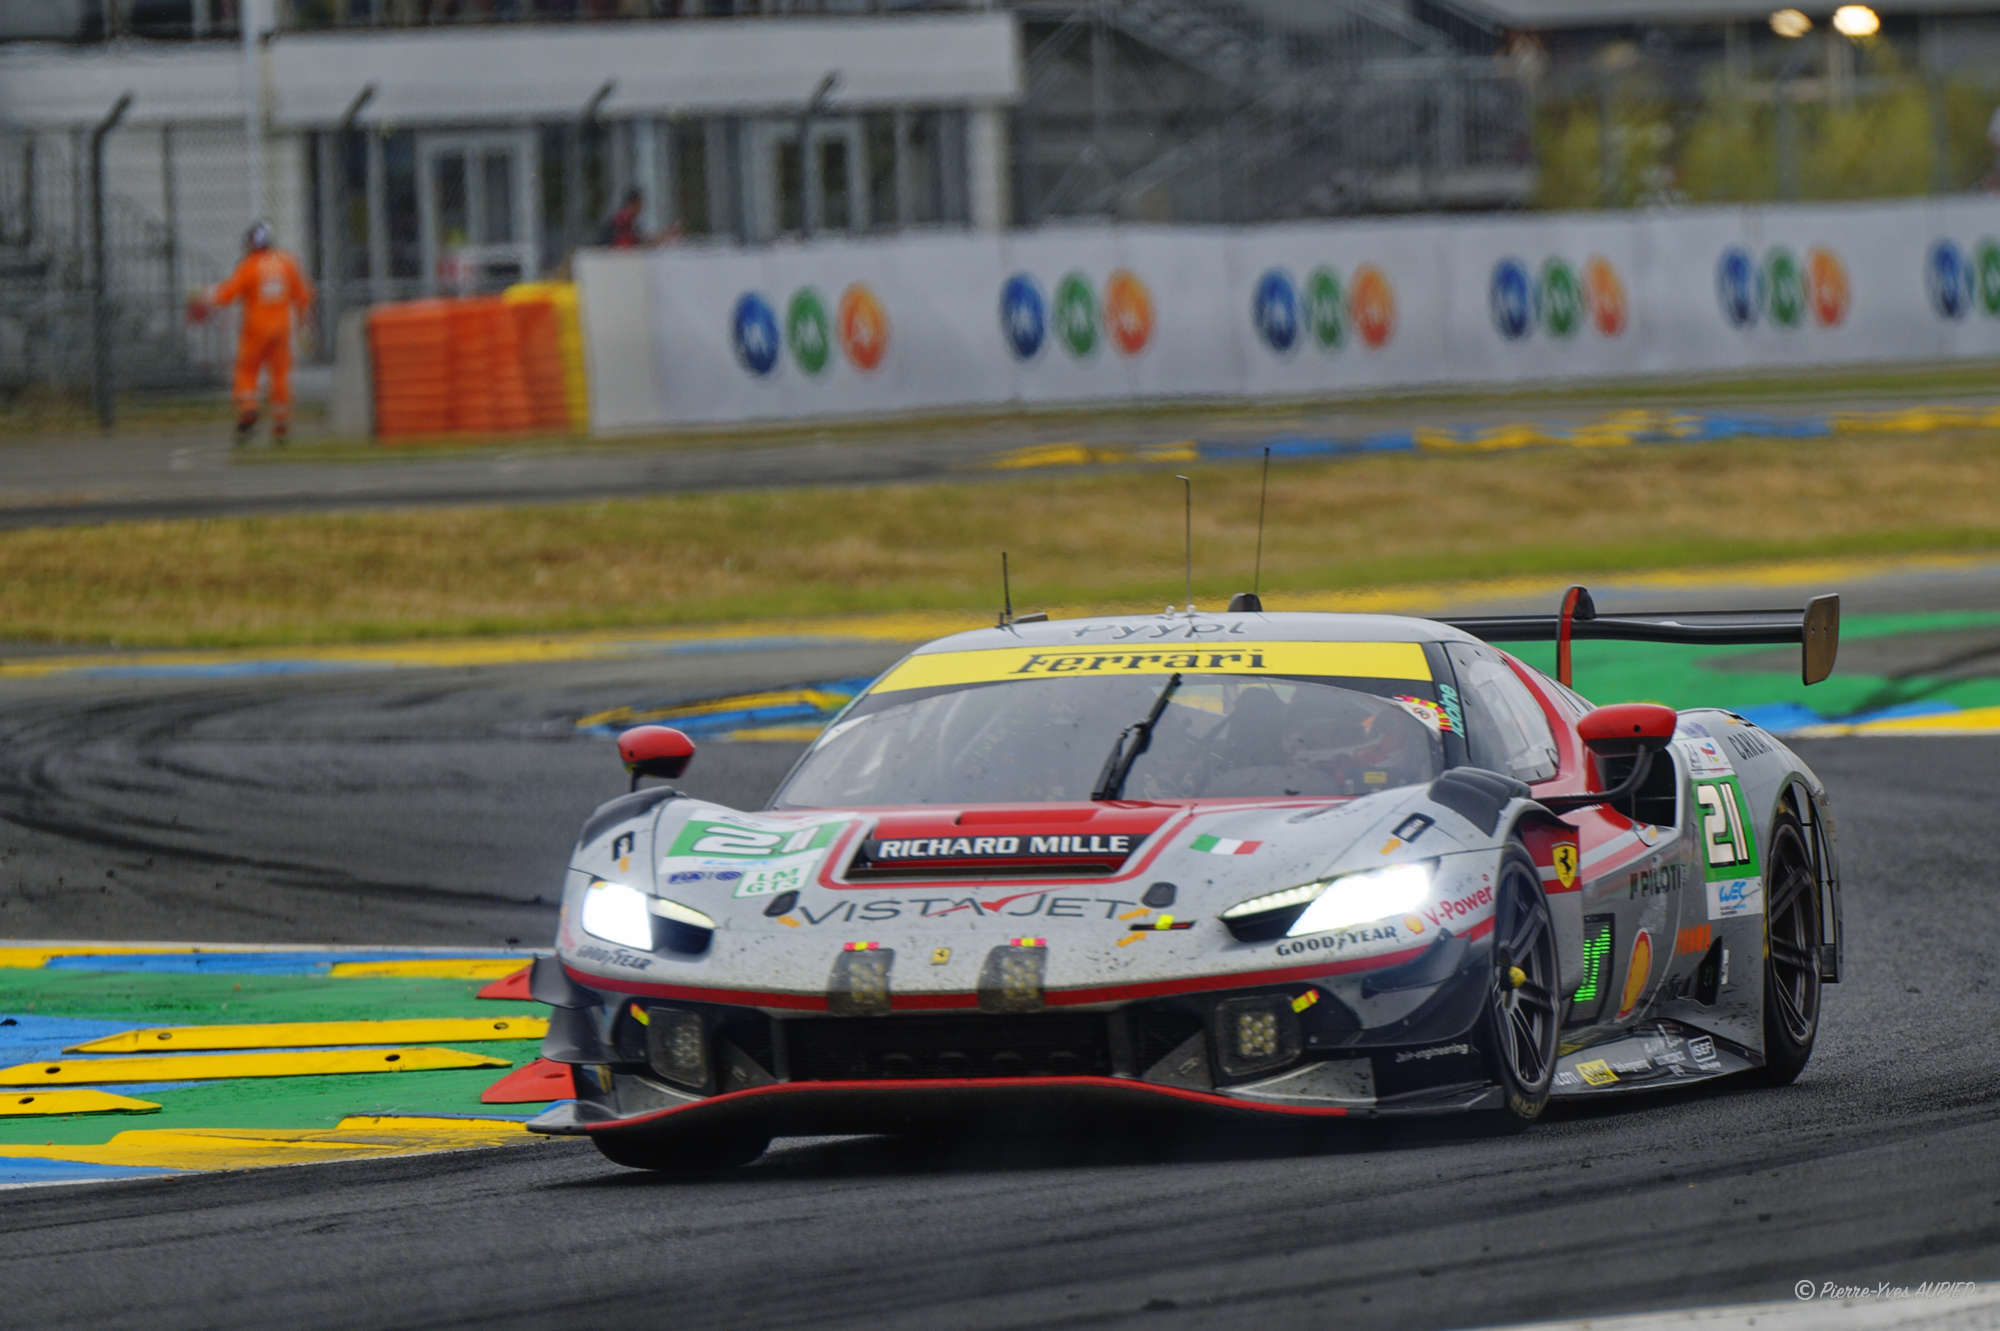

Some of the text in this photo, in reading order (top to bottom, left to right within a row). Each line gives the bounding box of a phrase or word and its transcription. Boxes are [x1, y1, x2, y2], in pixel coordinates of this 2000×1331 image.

[1009, 648, 1268, 674] Ferrari
[690, 825, 821, 856] 21
[1697, 782, 1750, 869] 21
[878, 835, 1130, 858] RICHARD MILLE
[1424, 886, 1493, 926] V-Power
